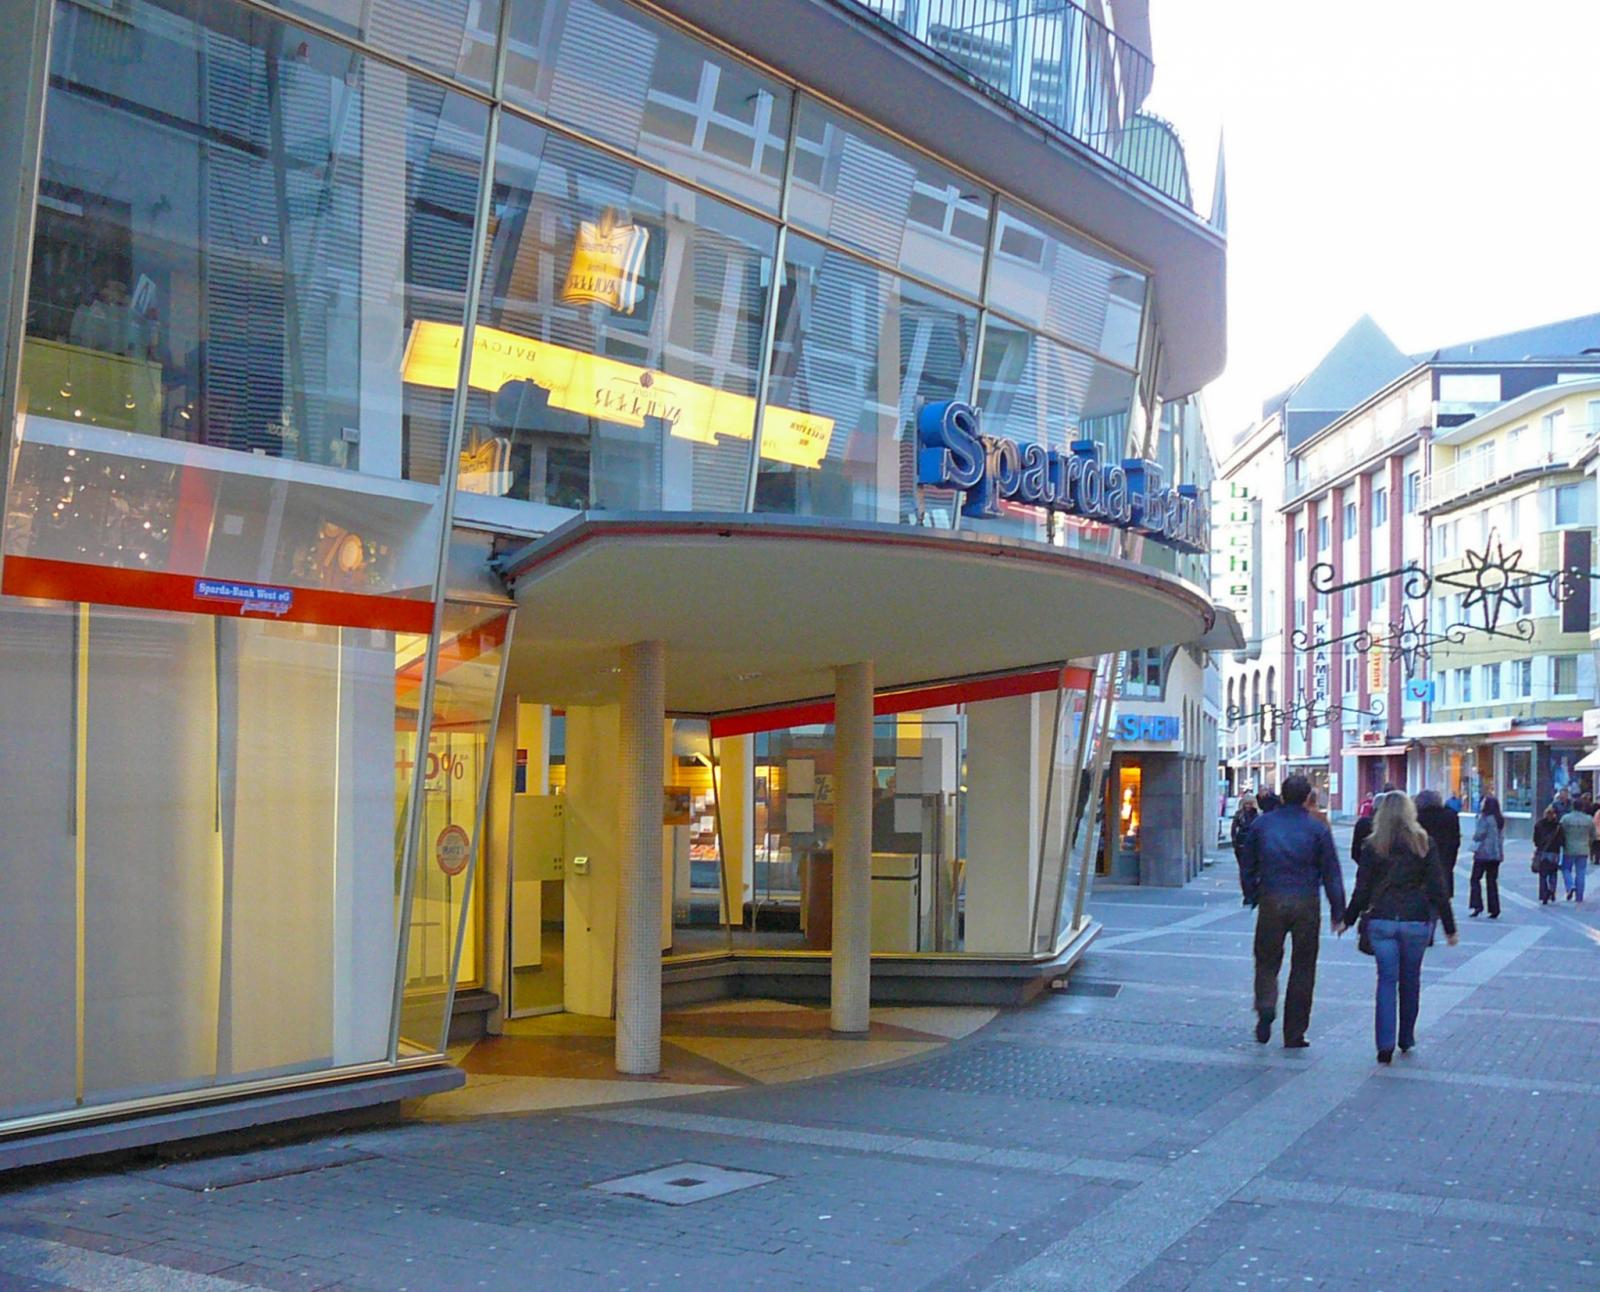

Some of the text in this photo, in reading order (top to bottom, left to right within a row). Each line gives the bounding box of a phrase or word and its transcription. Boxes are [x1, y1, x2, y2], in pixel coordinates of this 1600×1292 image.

[1230, 481, 1248, 613] büche
[198, 582, 255, 597] Sparda-Bank
[256, 589, 277, 600] West
